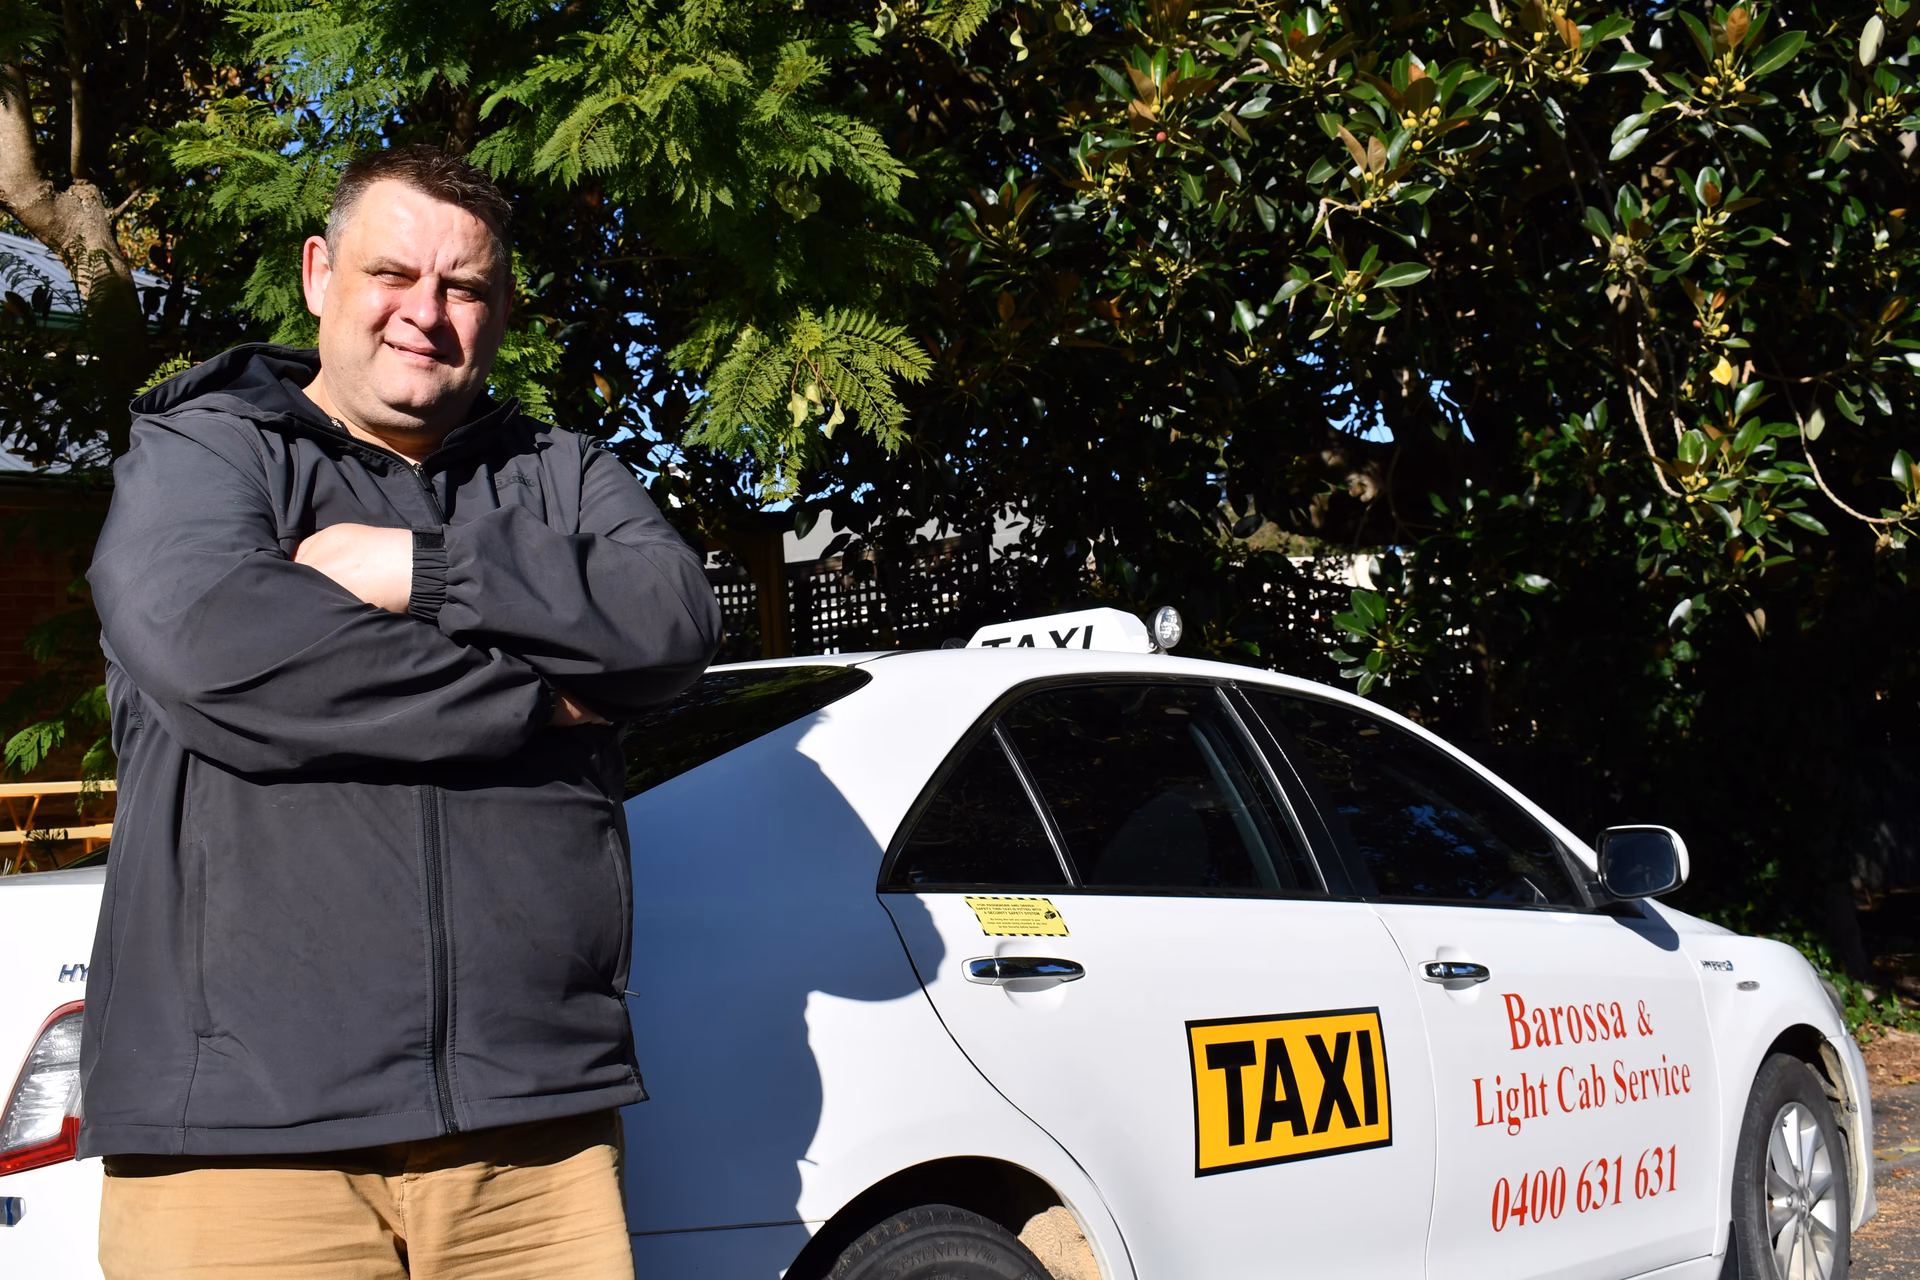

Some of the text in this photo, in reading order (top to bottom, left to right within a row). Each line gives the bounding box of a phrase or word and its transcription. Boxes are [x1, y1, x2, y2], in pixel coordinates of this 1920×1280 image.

[1501, 993, 1654, 1050] Barossa &
[1205, 1029, 1379, 1147] TAXI
[1472, 1054, 1691, 1136] Light Cab Service
[1491, 1144, 1677, 1232] 0400 631 631
